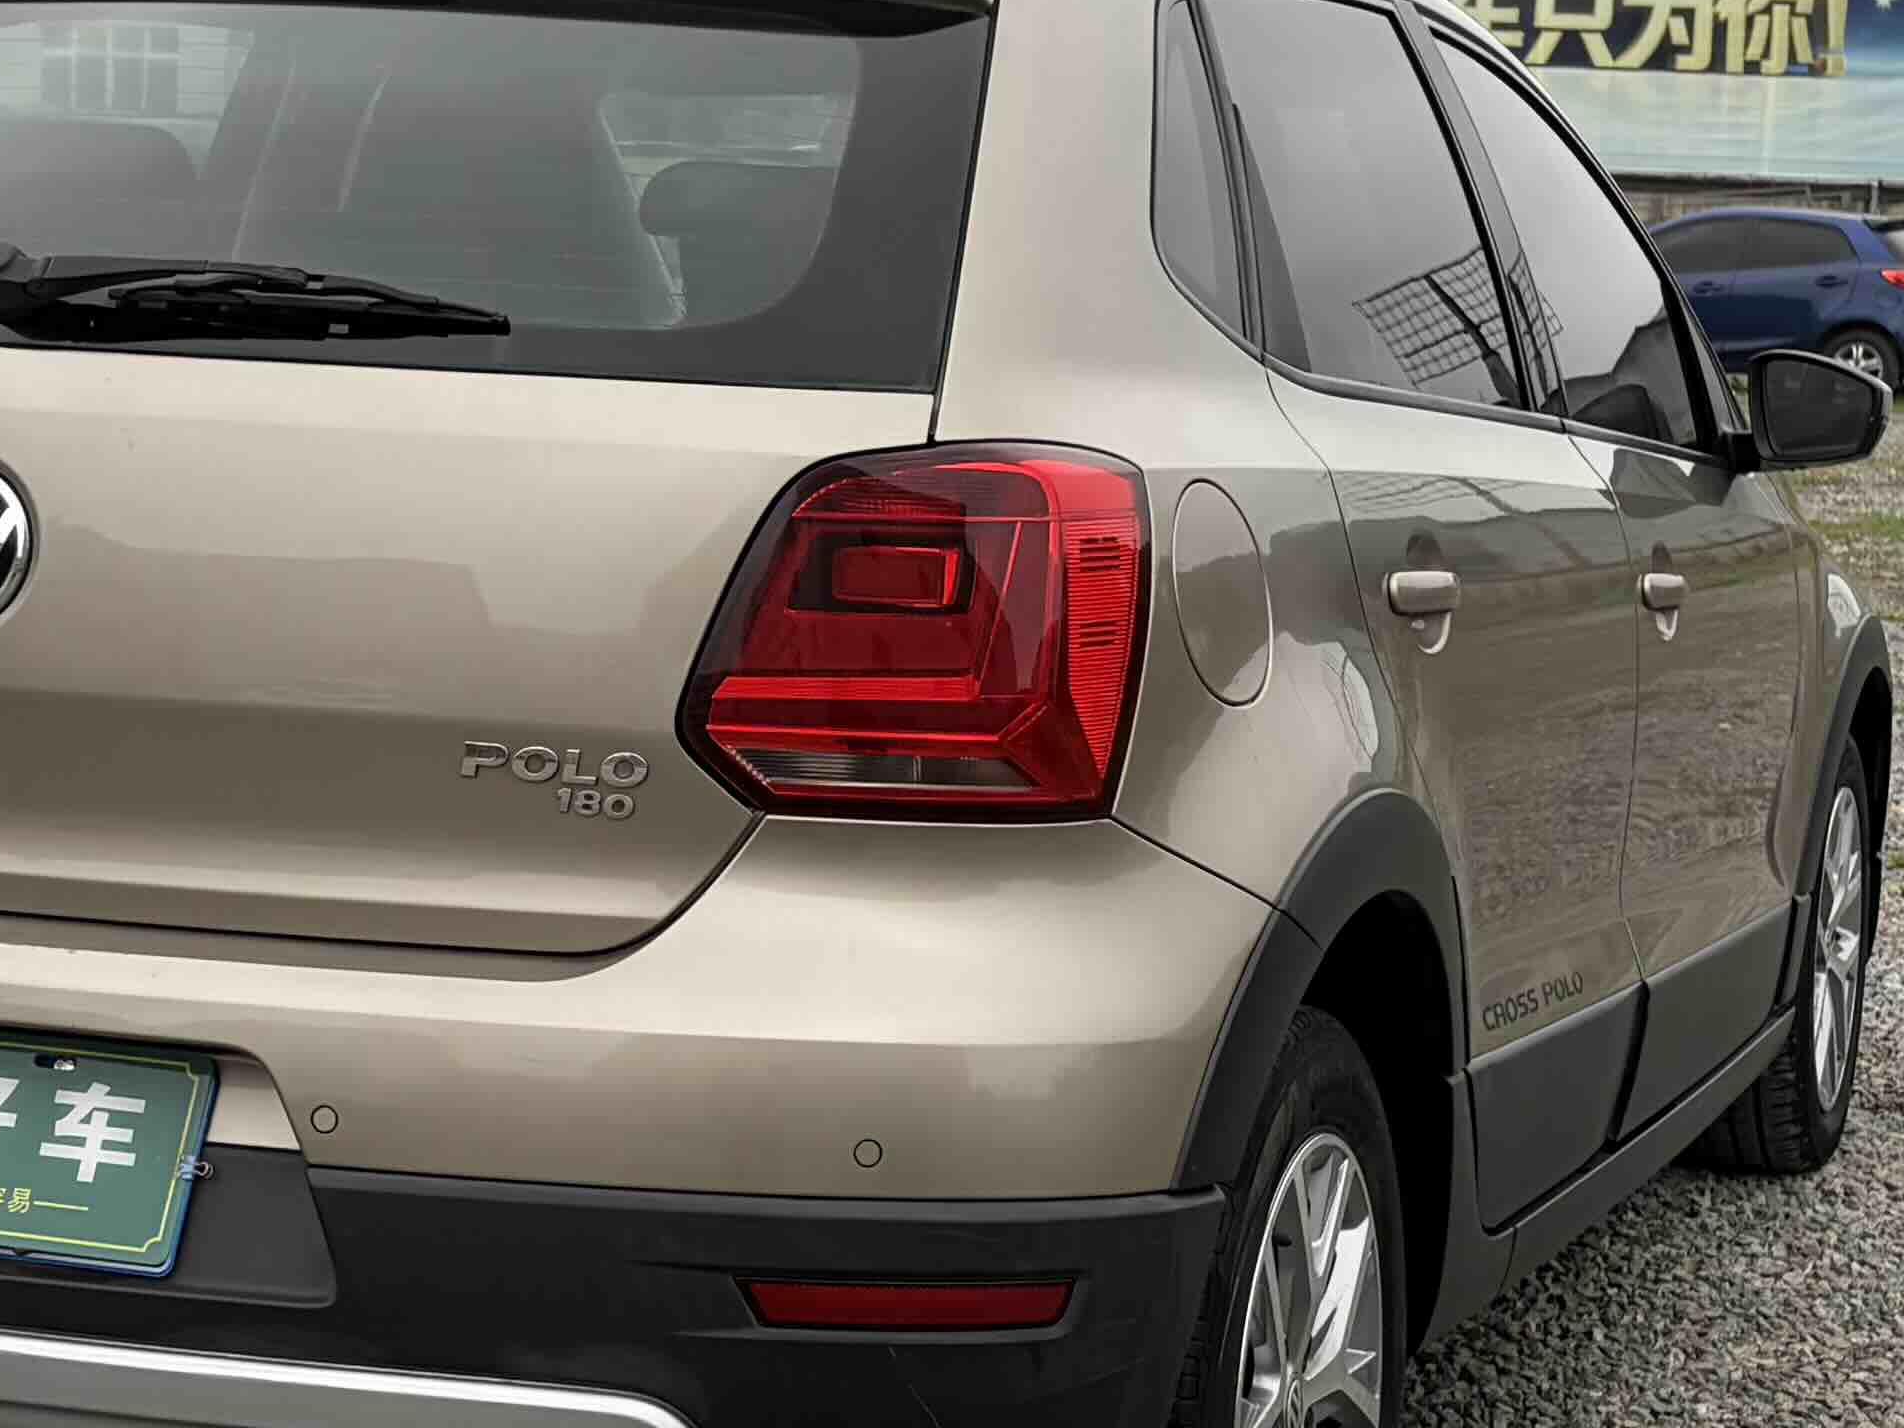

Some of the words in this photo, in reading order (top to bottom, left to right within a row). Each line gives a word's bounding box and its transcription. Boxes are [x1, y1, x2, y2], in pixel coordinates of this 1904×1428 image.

[459, 739, 650, 789] POLO
[555, 786, 637, 820] 180
[1482, 988, 1539, 1032] CROSS
[1543, 970, 1584, 1007] POLO
